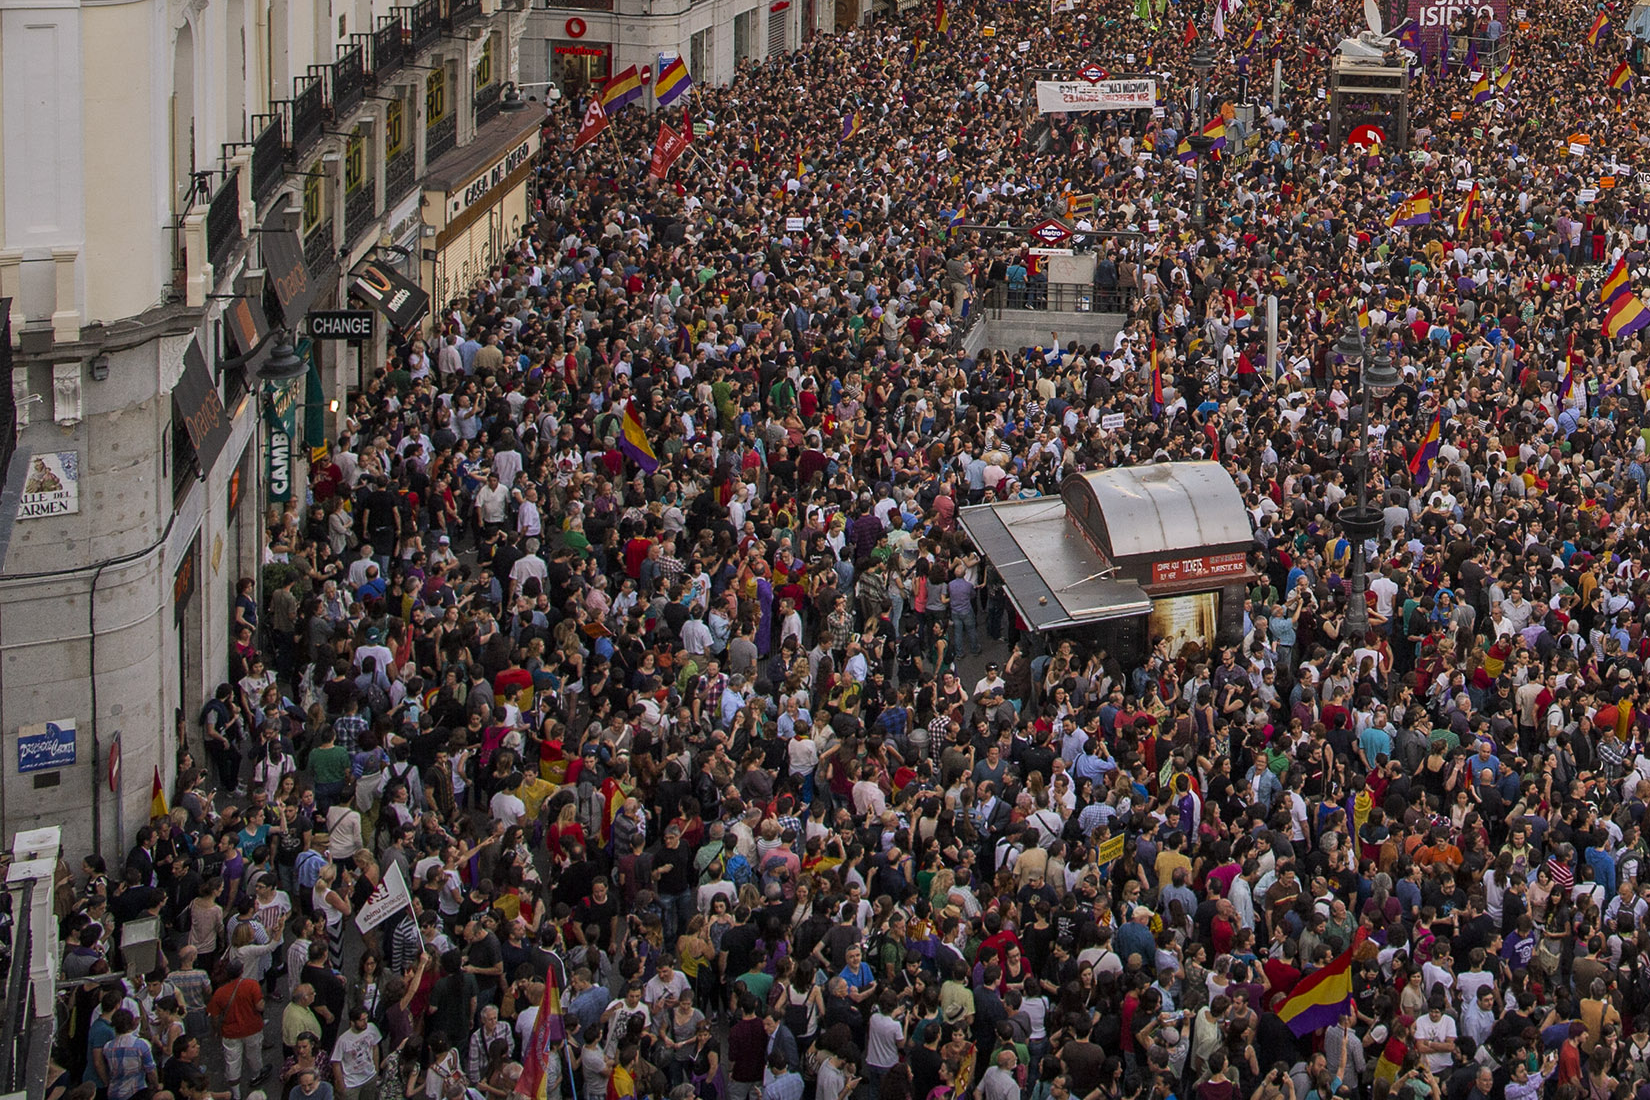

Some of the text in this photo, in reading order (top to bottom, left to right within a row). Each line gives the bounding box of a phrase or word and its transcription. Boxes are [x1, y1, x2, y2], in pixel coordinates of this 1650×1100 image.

[555, 45, 603, 56] vodafone
[465, 142, 529, 207] CASA DE DIEGO
[1041, 229, 1061, 237] Metro
[277, 261, 307, 306] Orange
[313, 318, 370, 334] CHANGE
[186, 389, 221, 450] Orange
[54, 491, 71, 500] DEL
[19, 501, 68, 517] ARMEN
